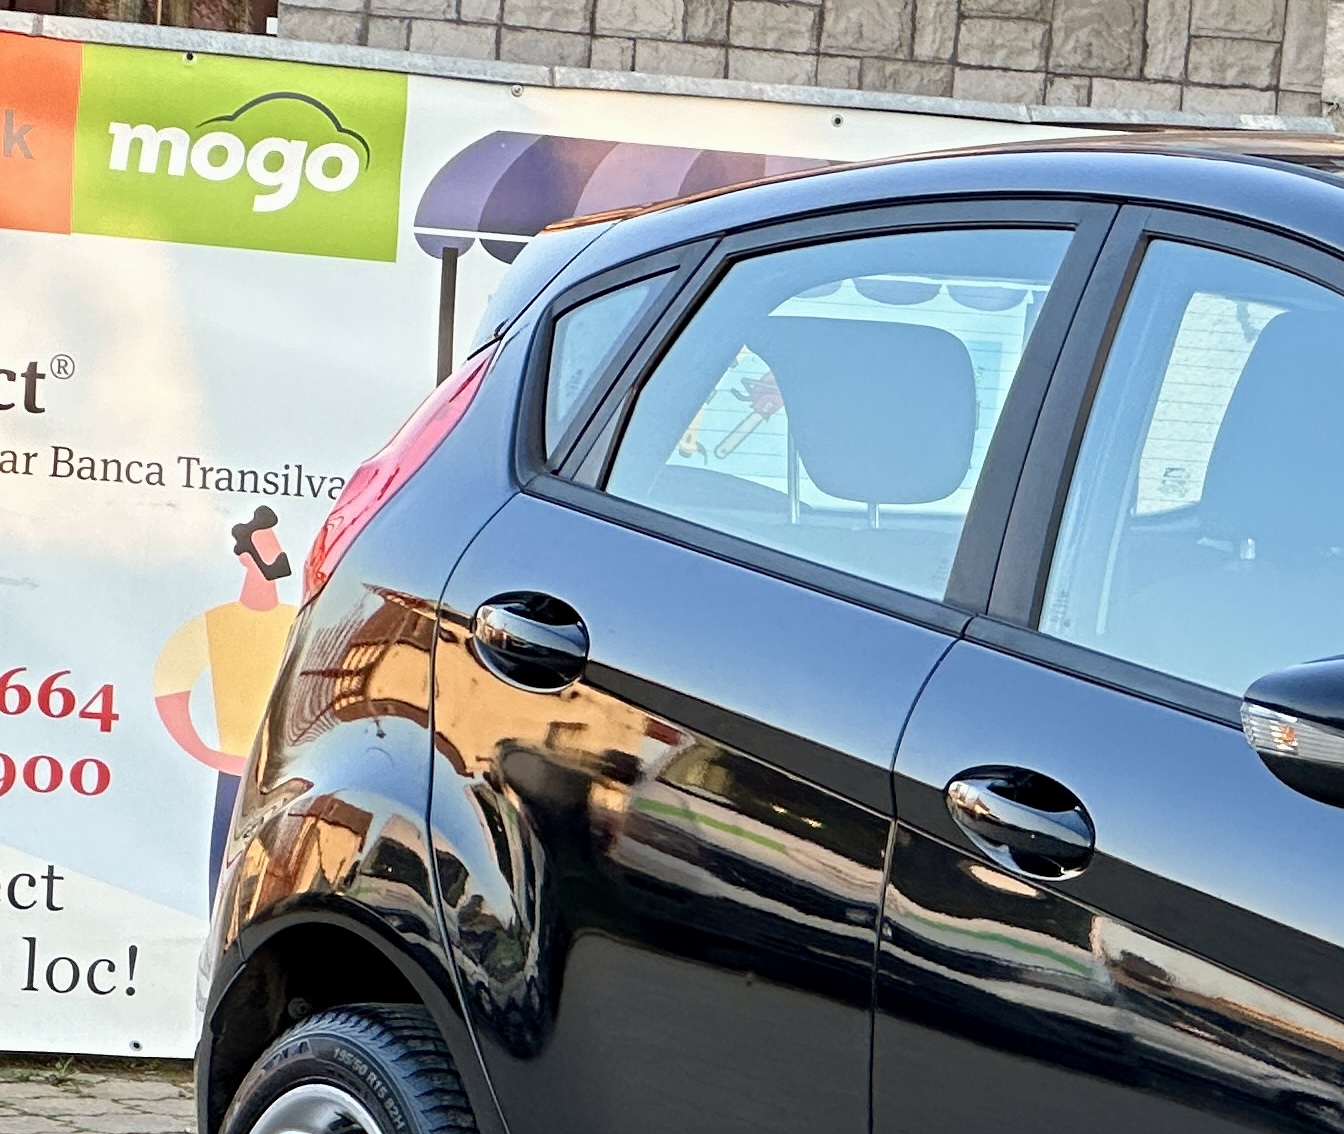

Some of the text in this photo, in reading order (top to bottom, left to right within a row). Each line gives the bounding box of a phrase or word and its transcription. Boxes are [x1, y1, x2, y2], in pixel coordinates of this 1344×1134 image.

[107, 121, 361, 212] mogo
[0, 449, 38, 476] ar
[49, 445, 166, 486] Banca
[21, 937, 138, 996] loc!
[333, 1047, 368, 1075] 195/50
[365, 1072, 388, 1098] R15
